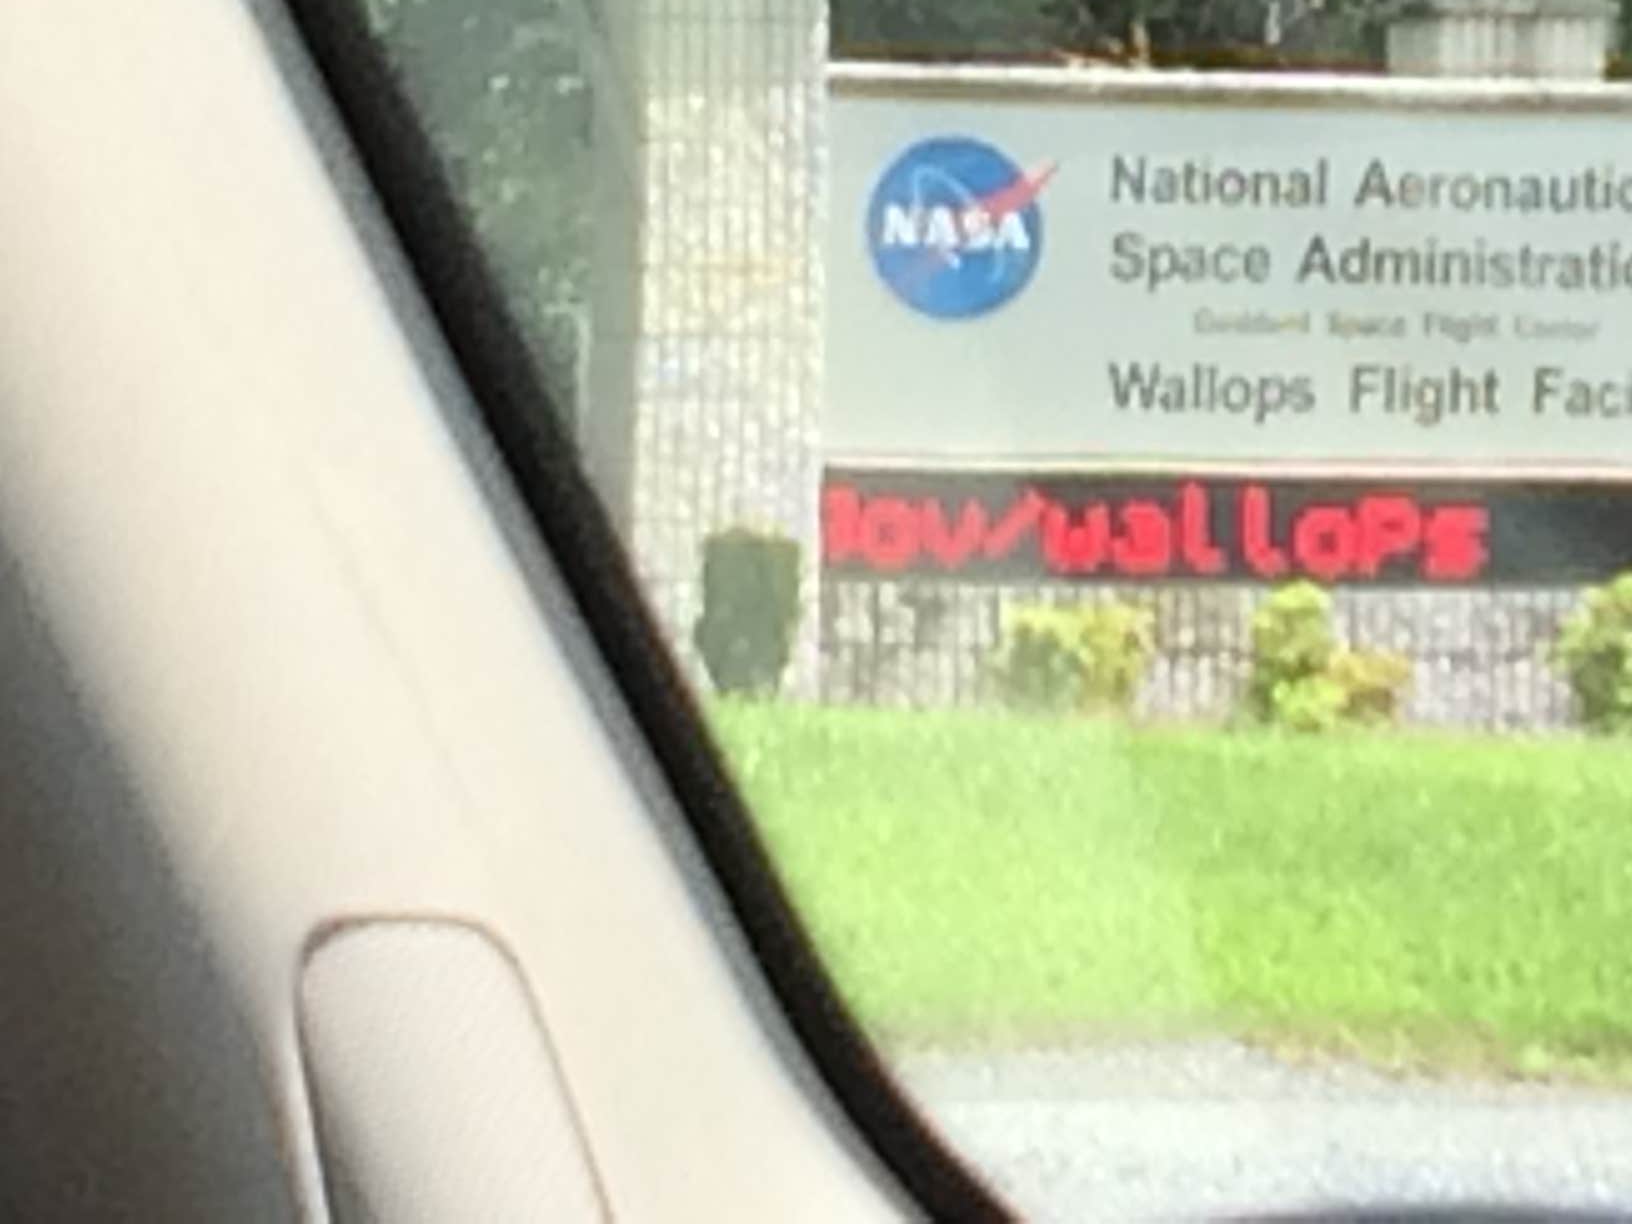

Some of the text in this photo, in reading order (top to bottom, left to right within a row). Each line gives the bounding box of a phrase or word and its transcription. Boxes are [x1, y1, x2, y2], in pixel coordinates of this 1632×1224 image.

[1111, 154, 1328, 208] National
[883, 204, 1030, 250] NASA
[1109, 231, 1271, 293] Space
[1108, 361, 1316, 426] Wallops
[1350, 364, 1500, 427] Flight
